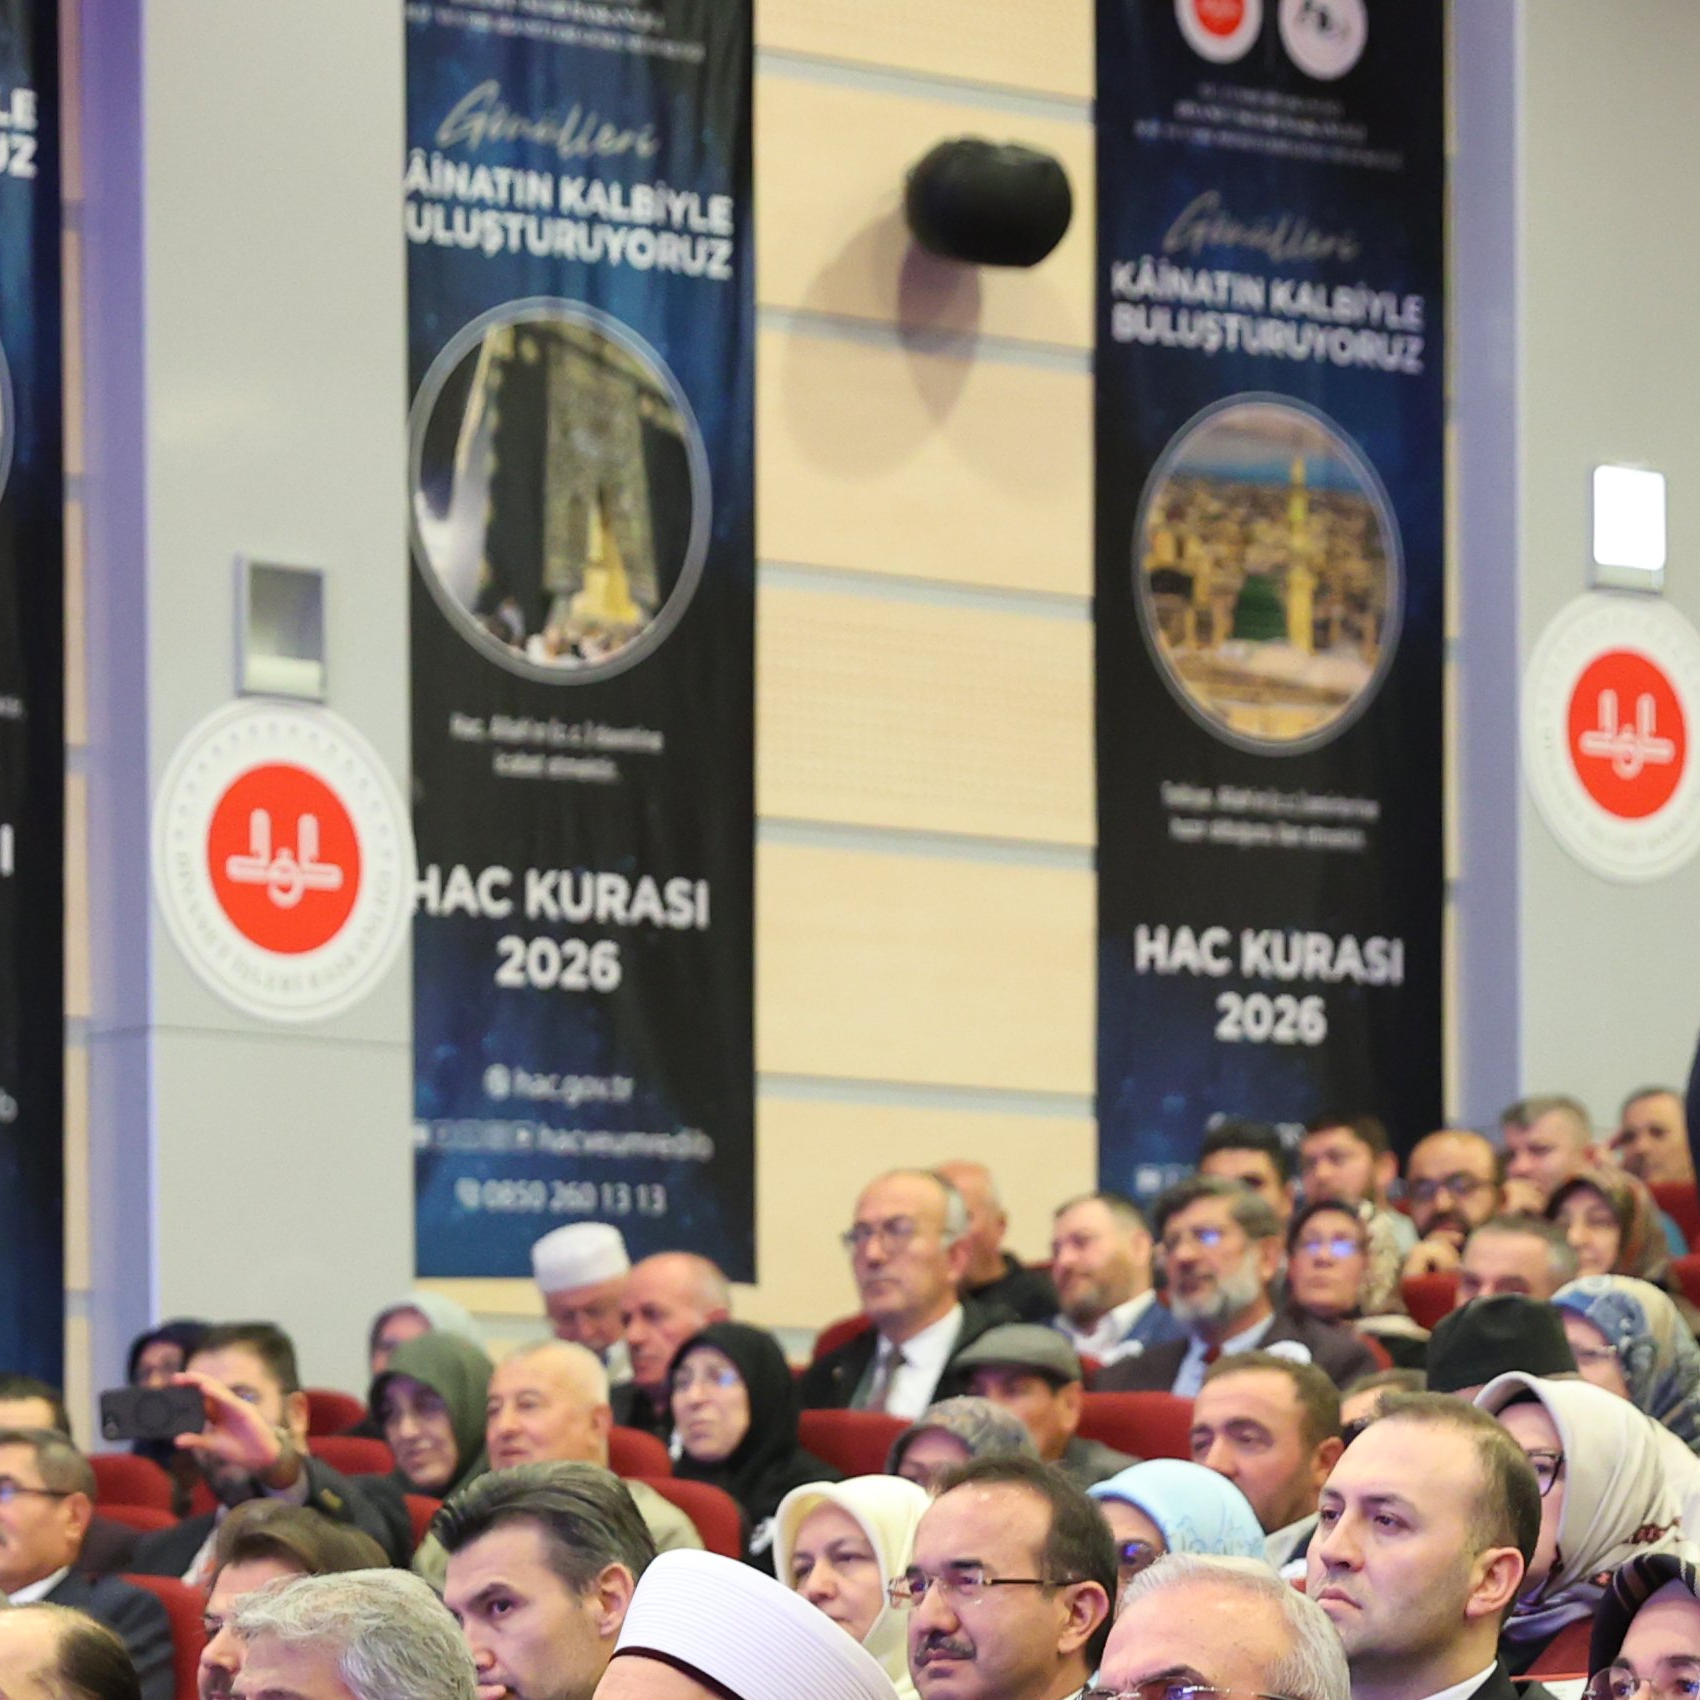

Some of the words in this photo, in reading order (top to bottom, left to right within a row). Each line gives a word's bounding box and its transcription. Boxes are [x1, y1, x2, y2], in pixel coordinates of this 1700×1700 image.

[404, 147, 554, 209] ÂİNATIN
[559, 174, 734, 236] KALBİYLE
[405, 200, 734, 280] ULUŞTURUYORUZ
[408, 864, 513, 919] HAC
[524, 867, 710, 930] KURASI
[494, 935, 622, 993] 2026
[1134, 923, 1232, 977] HAC
[1240, 927, 1405, 985] KURASI
[1214, 991, 1328, 1047] 2026
